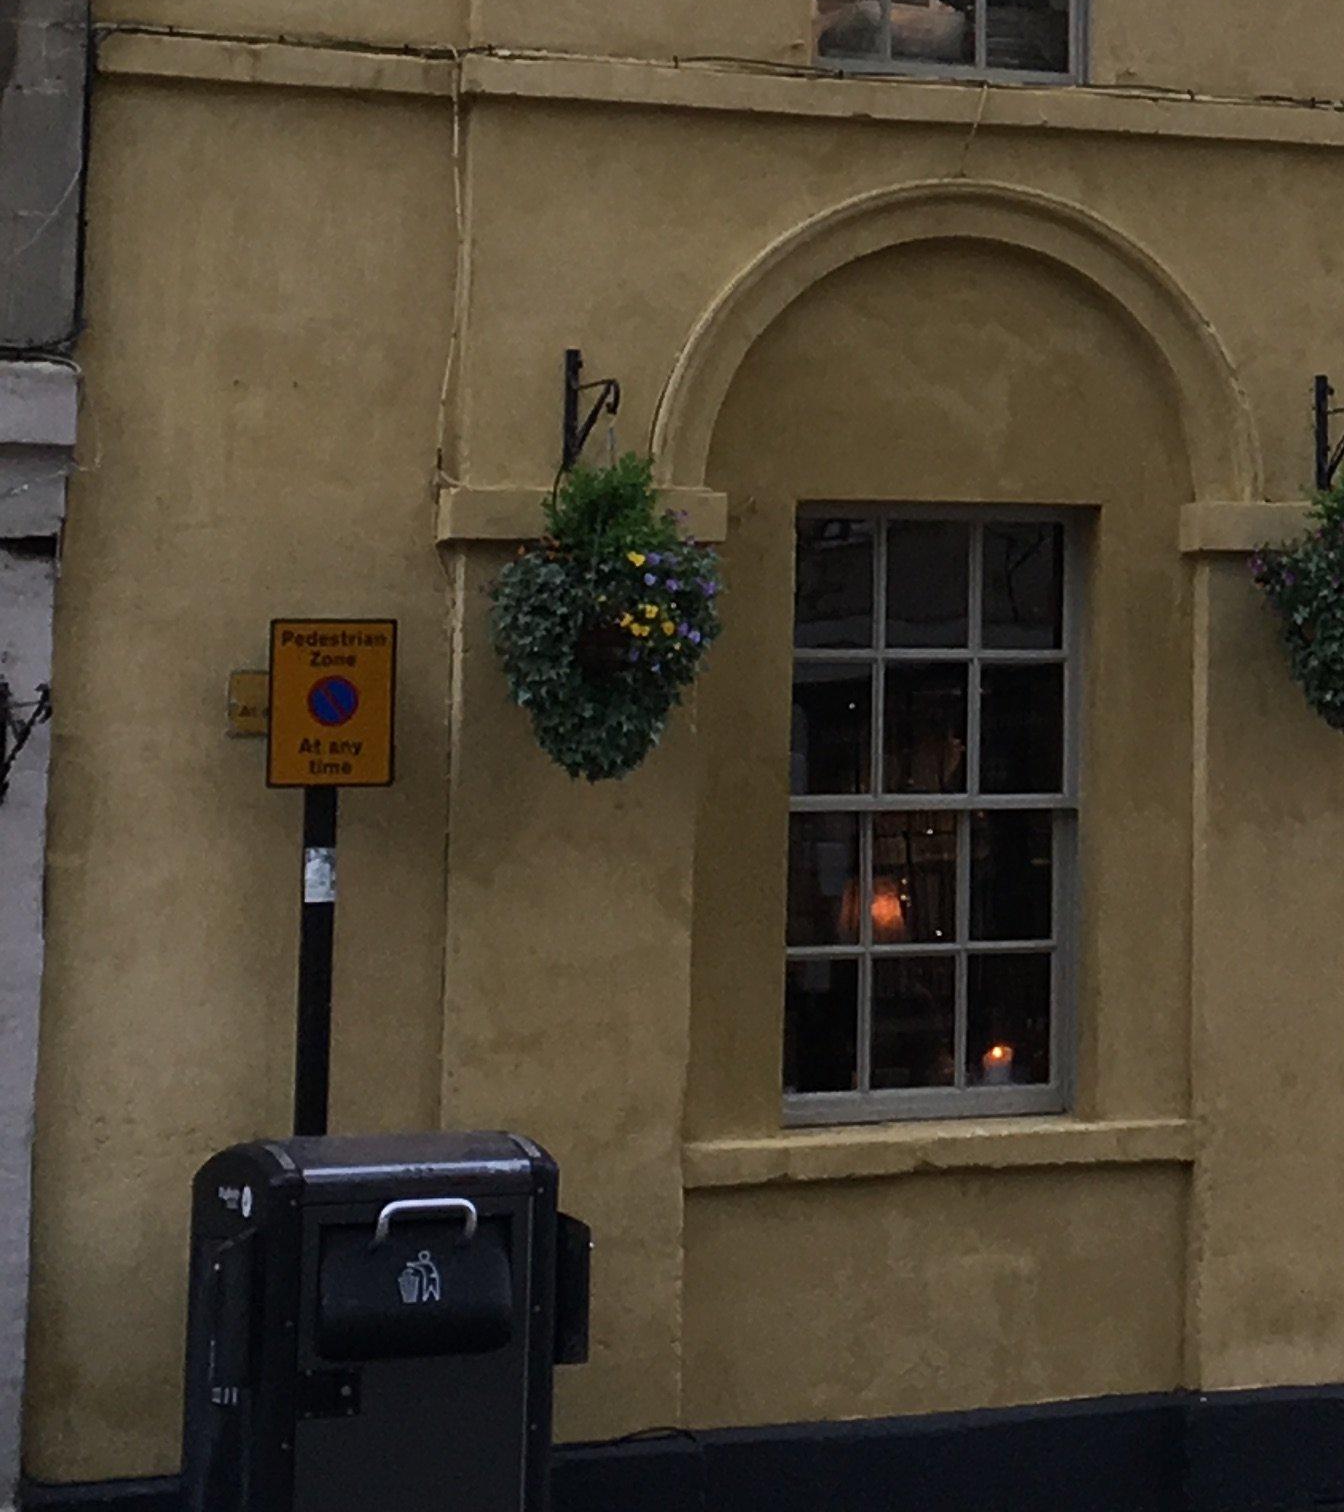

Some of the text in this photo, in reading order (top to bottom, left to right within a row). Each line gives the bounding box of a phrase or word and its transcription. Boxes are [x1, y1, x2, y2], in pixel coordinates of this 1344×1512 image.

[282, 630, 388, 646] Pedestrian
[310, 650, 356, 667] Zone
[298, 737, 364, 756] At any
[309, 760, 352, 774] time
